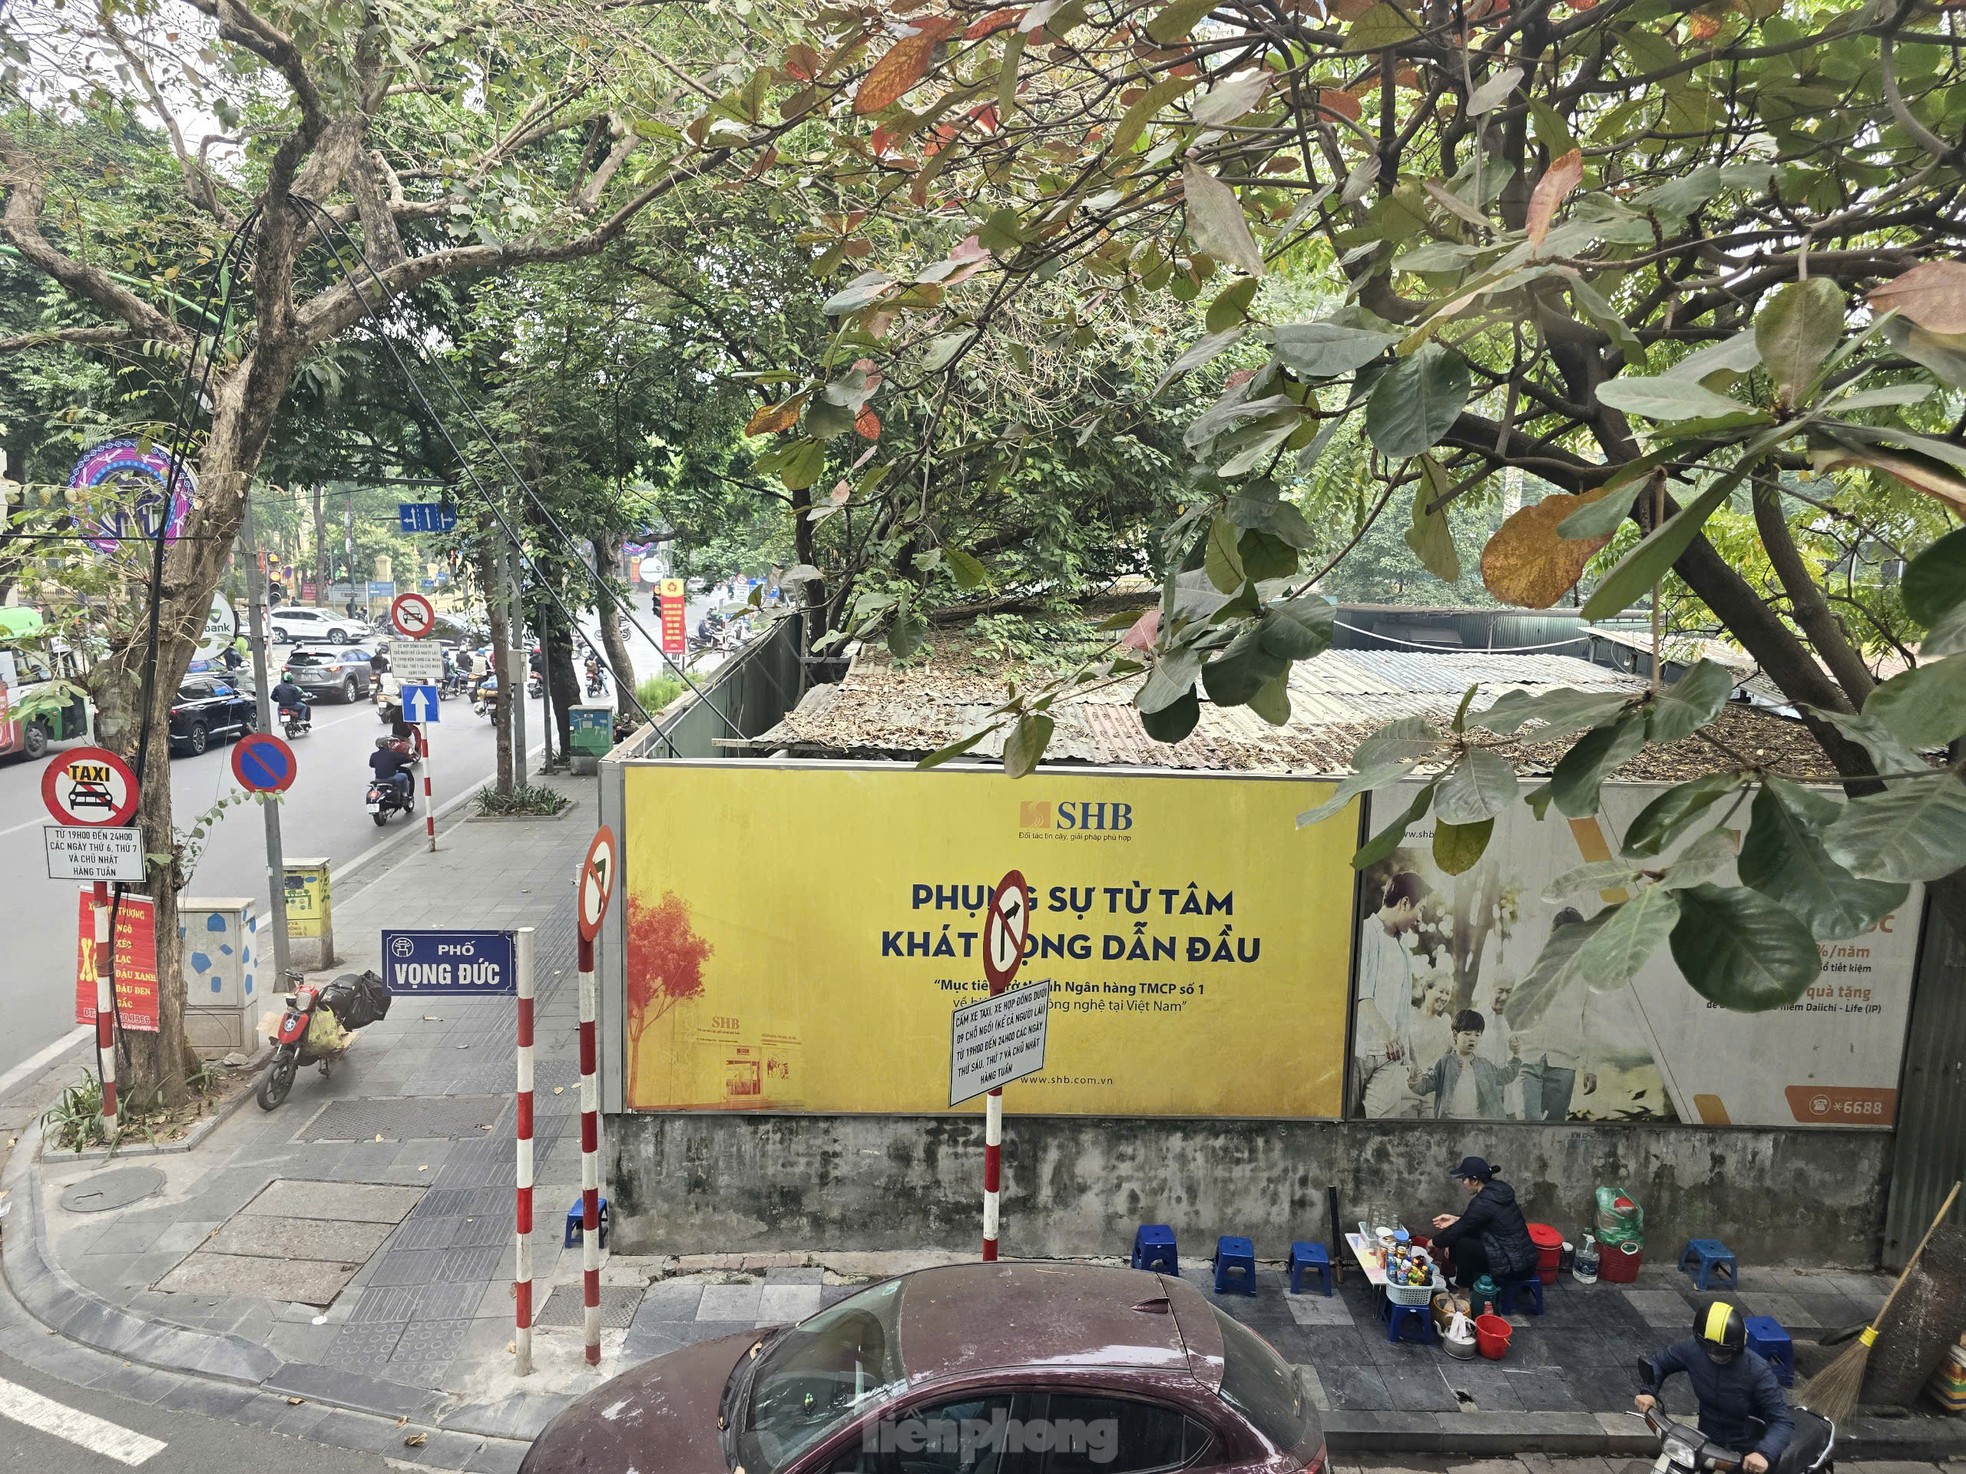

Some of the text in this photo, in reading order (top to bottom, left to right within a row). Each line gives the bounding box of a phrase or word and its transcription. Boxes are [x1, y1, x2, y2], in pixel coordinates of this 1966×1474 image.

[70, 765, 110, 782] TAXI
[1056, 801, 1133, 830] SHB
[55, 830, 133, 841] TỪ 19H00 ĐẾN 24H00
[1084, 833, 1101, 841] pháp
[1118, 834, 1132, 842] hợp
[50, 842, 65, 850] CÁC
[67, 842, 86, 852] NGÀY
[90, 842, 104, 852] THỨ
[116, 842, 131, 852] THỨ
[69, 853, 118, 866] VÀ CHỦ NHẬT
[73, 865, 116, 877] HÀNG TUẦN
[912, 880, 1234, 920] PHỤG SỰ TỪ TÂM
[438, 940, 476, 956] PHỐ
[882, 922, 1261, 967] KHÁT ỌNG DẪN ĐẦU
[394, 958, 500, 988] VỌNG ĐỨC
[1849, 963, 1872, 973] kiệm
[134, 971, 156, 982] XANH
[972, 979, 989, 991] tiê
[1065, 981, 1099, 995] Ngân
[1103, 982, 1136, 996] hàng
[1139, 983, 1176, 994] TMCP
[1179, 982, 1195, 995] số
[1198, 984, 1204, 994] 1
[1806, 986, 1872, 1002] quà tặng
[956, 1012, 968, 1028] CẤM
[970, 1010, 978, 1022] XE
[994, 1003, 1002, 1013] XE
[1004, 998, 1015, 1010] HỢP
[1016, 992, 1032, 1006] ĐỒNG
[1048, 998, 1070, 1012] ông
[1074, 999, 1105, 1012] nghệ
[1109, 1000, 1124, 1012] tại
[1126, 1000, 1150, 1013] Việt
[1806, 1003, 1837, 1012] Daiichi
[1845, 1004, 1864, 1013] Life
[712, 1016, 740, 1030] SHB
[957, 1034, 964, 1044] 09
[966, 1026, 978, 1041] CHỖ
[979, 1022, 993, 1036] NGỒI
[1006, 1015, 1014, 1026] CẢ
[1016, 1008, 1033, 1022] NGƯỜI
[957, 1020, 1043, 1061] TỪ 19H00 ĐẾN 24H00 CÁC NGÀY
[958, 1064, 970, 1077] THỨ
[986, 1054, 998, 1065] THỨ
[1000, 1052, 1003, 1061] 7
[1004, 1048, 1011, 1059] VÀ
[1012, 1041, 1024, 1056] CHỦ
[1025, 1038, 1040, 1051] NHẬT
[980, 1064, 1013, 1084] HÀNG TUẦN
[1020, 1076, 1113, 1085] www.shb.com.vn
